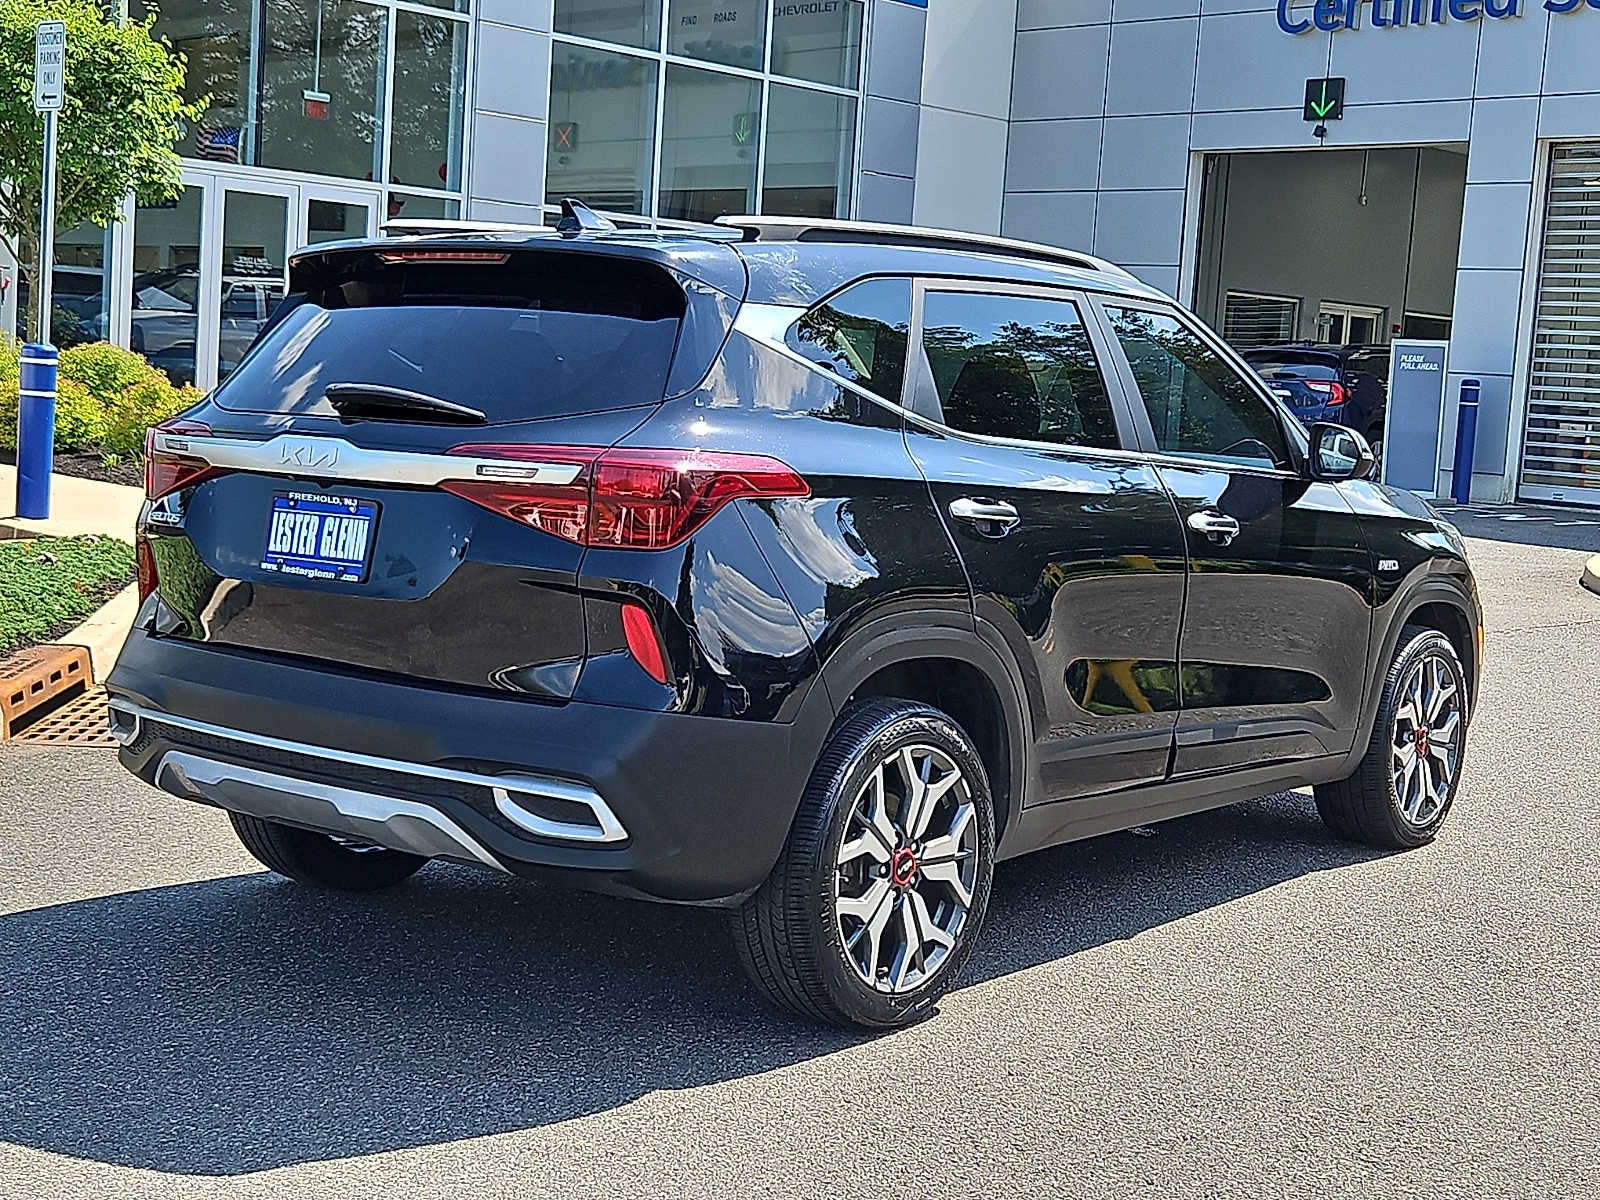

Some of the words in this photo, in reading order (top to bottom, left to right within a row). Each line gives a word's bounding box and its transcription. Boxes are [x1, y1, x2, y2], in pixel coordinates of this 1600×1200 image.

[680, 15, 698, 26] FIND
[713, 12, 737, 24] ROADS
[39, 50, 61, 65] PARKING
[43, 71, 57, 85] ONLY
[1400, 354, 1425, 362] PLEASE
[1400, 362, 1416, 370] PULL
[288, 492, 343, 506] FREEHOLD,
[344, 497, 358, 506] NJ
[268, 511, 320, 556] LESTER
[320, 516, 370, 562] GLENN
